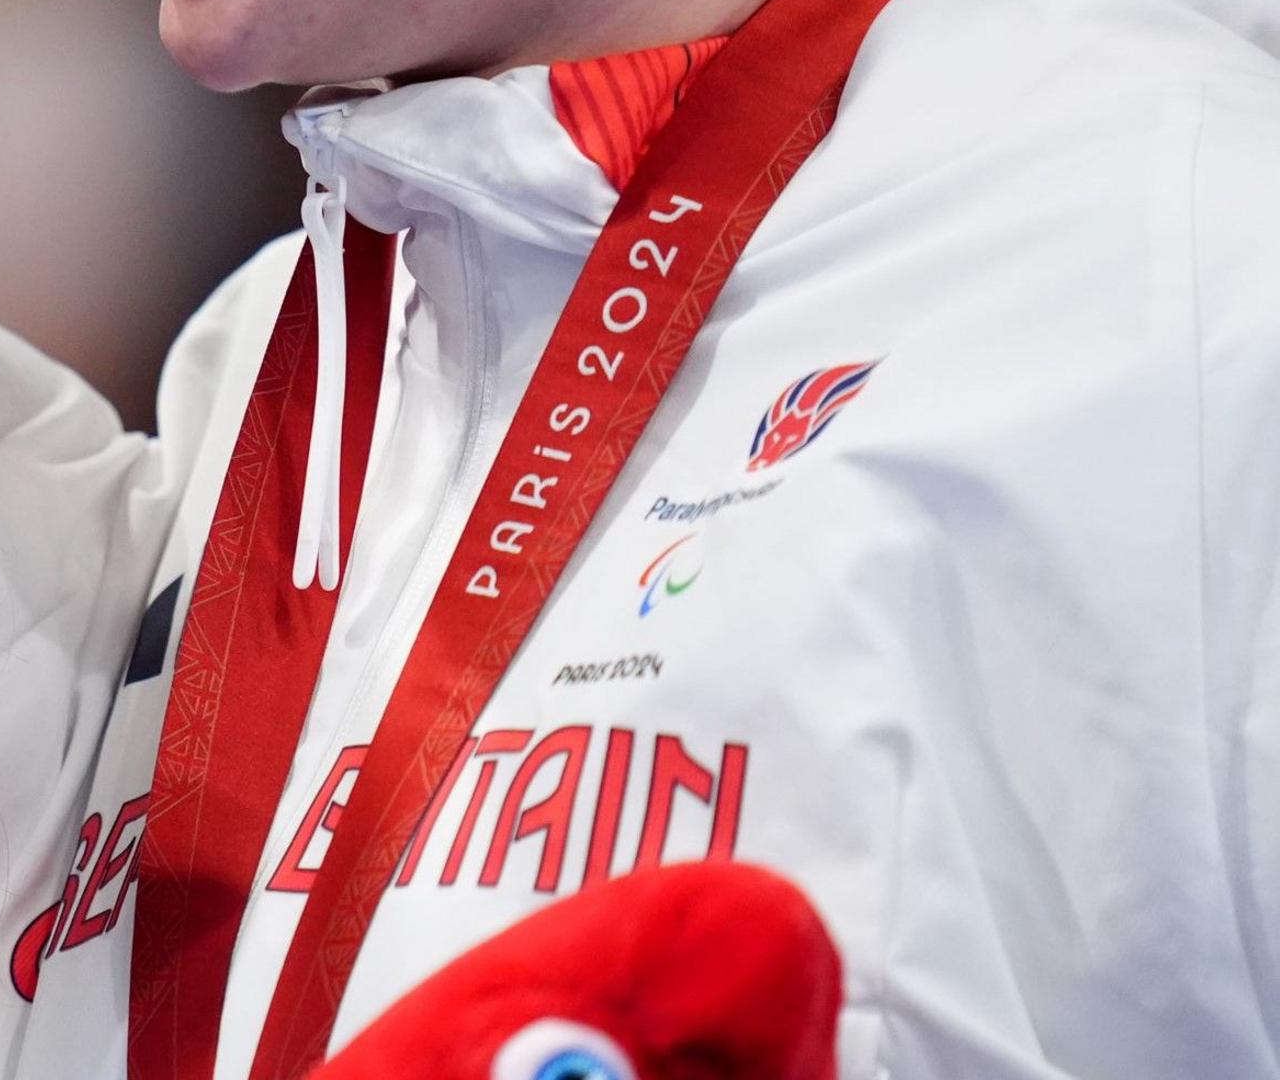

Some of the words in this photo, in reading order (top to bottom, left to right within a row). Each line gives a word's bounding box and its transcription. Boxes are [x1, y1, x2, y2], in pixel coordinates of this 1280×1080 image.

[578, 194, 702, 381] 2024
[609, 651, 665, 680] 2024
[265, 724, 749, 895] BITAIN
